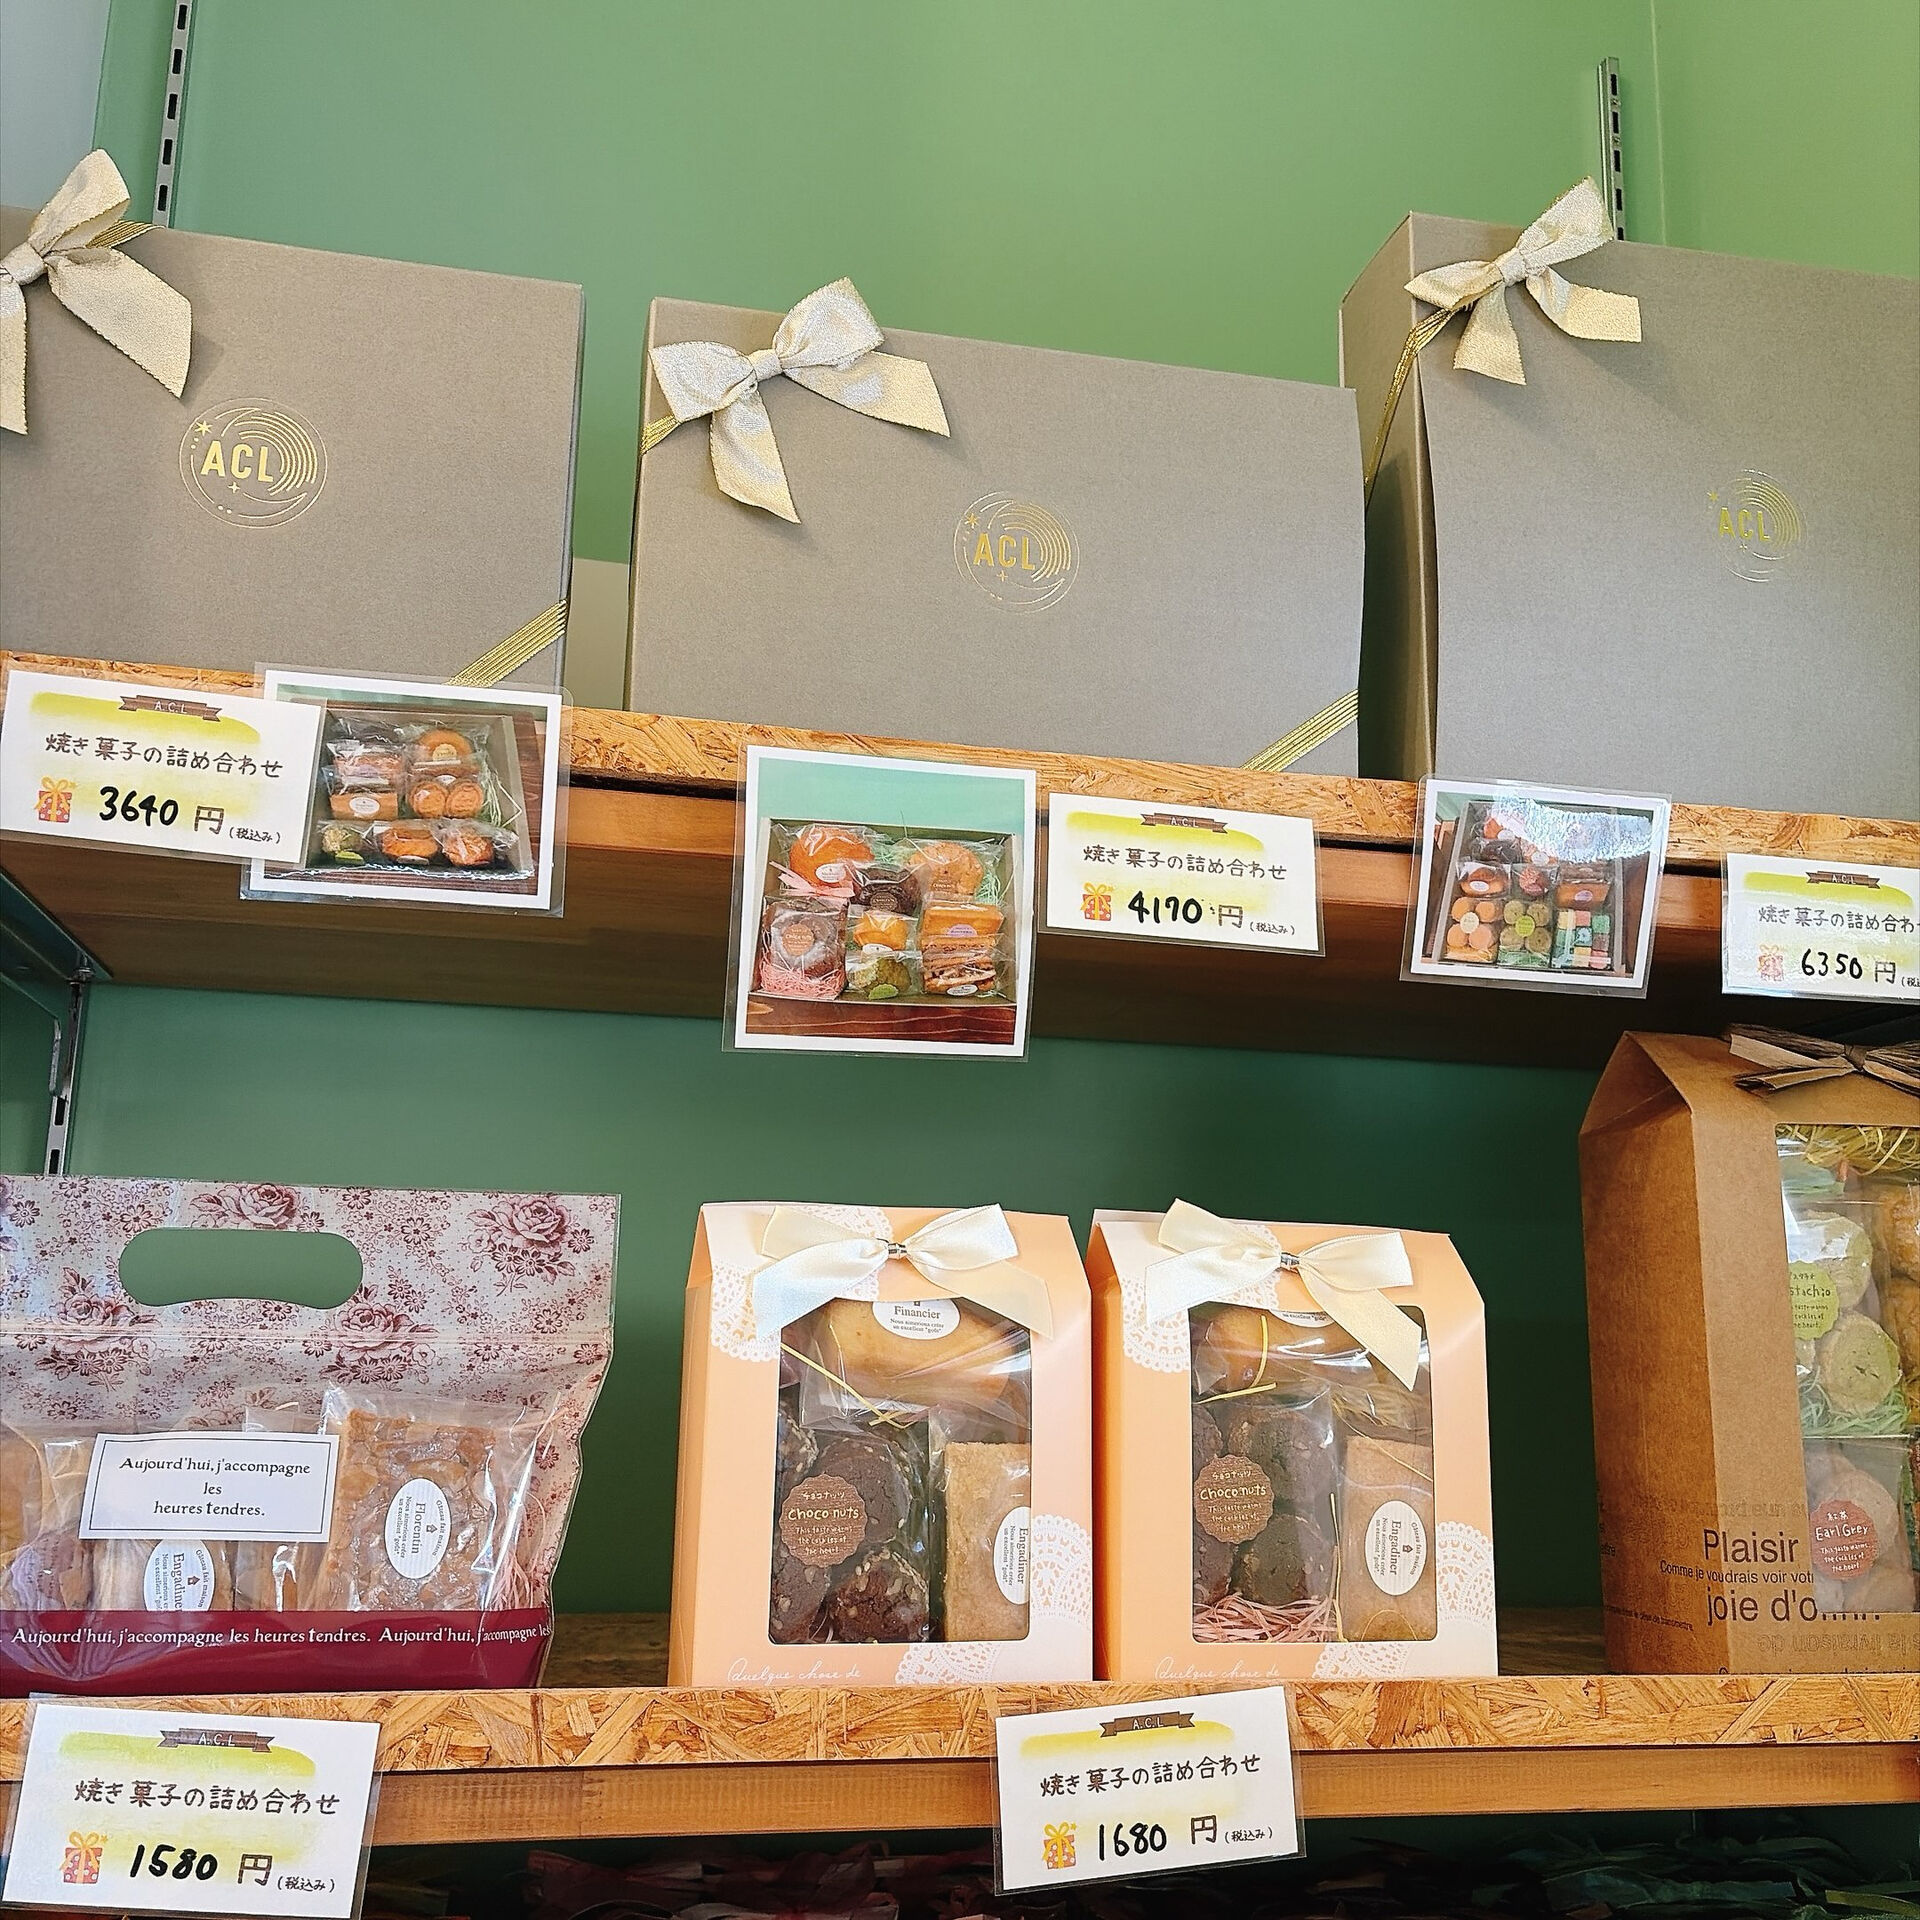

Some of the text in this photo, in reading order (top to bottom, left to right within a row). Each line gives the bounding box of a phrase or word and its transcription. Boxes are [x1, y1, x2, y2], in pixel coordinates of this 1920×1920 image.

[200, 440, 274, 482] ACL
[1718, 507, 1770, 541] ACL
[973, 532, 1036, 570] ACL
[154, 701, 187, 714] A.C.L
[99, 785, 179, 826] 3640
[194, 805, 225, 835] 円
[1171, 816, 1199, 828] A.C.L
[1832, 874, 1856, 885] A.C.L
[1218, 904, 1243, 928] 円
[1758, 905, 1920, 933] 焼き菓子の詰め合わ
[1801, 948, 1863, 979] 6350
[1874, 961, 1896, 984] 円
[894, 1305, 941, 1319] Financier
[119, 1457, 311, 1478] Aujourd'hui, j'accompagne
[203, 1482, 222, 1495] les
[1200, 1484, 1267, 1500] Choco nuts
[153, 1500, 265, 1517] heures tendres.
[788, 1506, 859, 1520] Choco nuts
[411, 1502, 426, 1554] Florentin
[1815, 1523, 1868, 1541] Earl Grey
[1016, 1527, 1029, 1584] Engadiner
[1389, 1520, 1402, 1576] Engadiner
[1703, 1528, 1799, 1563] Plaisir
[1659, 1559, 1694, 1578] Comme
[1695, 1565, 1704, 1580] je
[1706, 1569, 1759, 1584] voudrais
[1762, 1570, 1787, 1584] voir
[1706, 1586, 1758, 1626] joie
[11, 1628, 116, 1648] Aujourd'hui,
[117, 1629, 223, 1649] j'accompagne
[229, 1628, 250, 1643] les
[254, 1628, 305, 1643] heures
[308, 1628, 371, 1643] tendres.
[378, 1627, 475, 1646] Aujourd'hui,
[476, 1626, 537, 1647] j'accompagne
[727, 1657, 862, 1684] Quelque chose de
[1154, 1656, 1280, 1680] Quelque chose de
[1132, 1716, 1164, 1730] A.C.L
[199, 1732, 236, 1747] A.C.L
[1098, 1822, 1167, 1861] 1680
[1190, 1814, 1217, 1845] 円
[129, 1844, 218, 1881] 1580
[238, 1853, 272, 1887] 円
